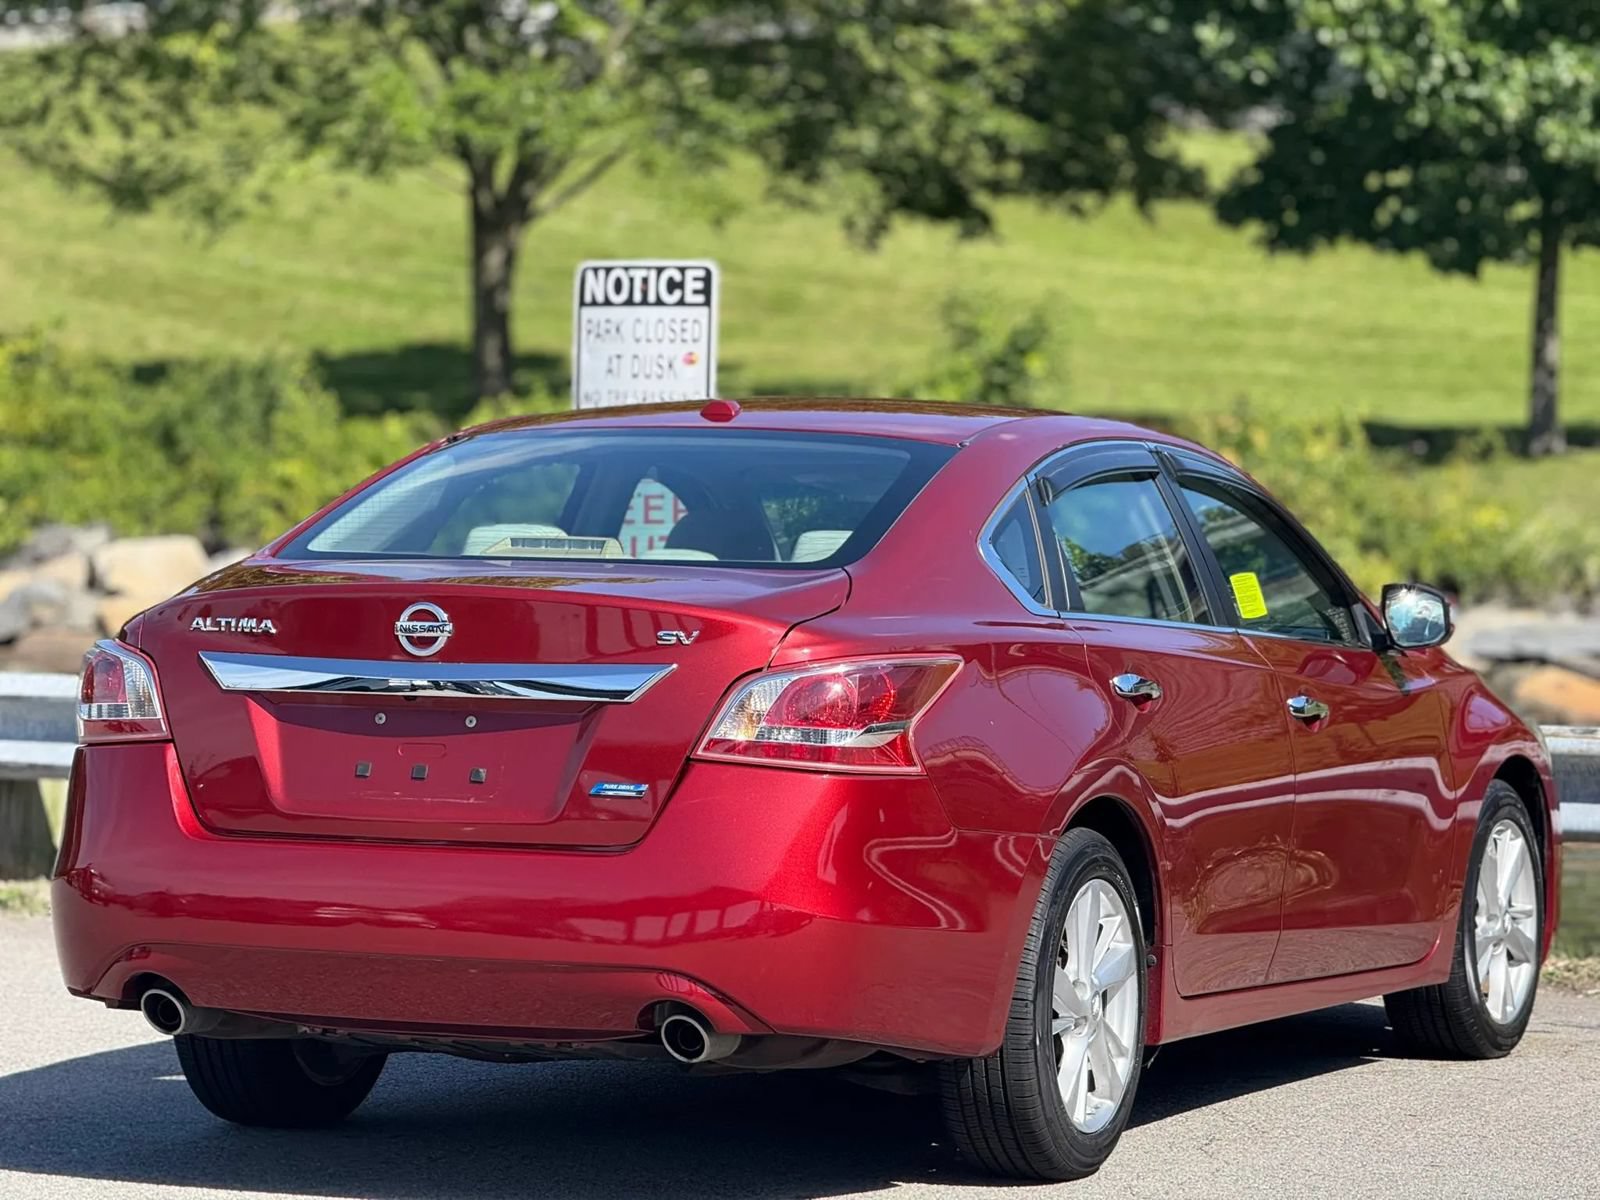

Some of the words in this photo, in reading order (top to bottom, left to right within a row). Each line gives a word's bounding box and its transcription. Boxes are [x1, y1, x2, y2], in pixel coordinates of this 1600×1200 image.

[583, 267, 707, 305] NOTICE
[585, 318, 625, 344] PARK
[632, 318, 702, 343] CLOSED
[605, 354, 622, 379] AT
[631, 354, 678, 380] DUSK
[190, 617, 277, 634] ALTIMA
[400, 624, 445, 634] NISSAN
[656, 630, 700, 645] SV
